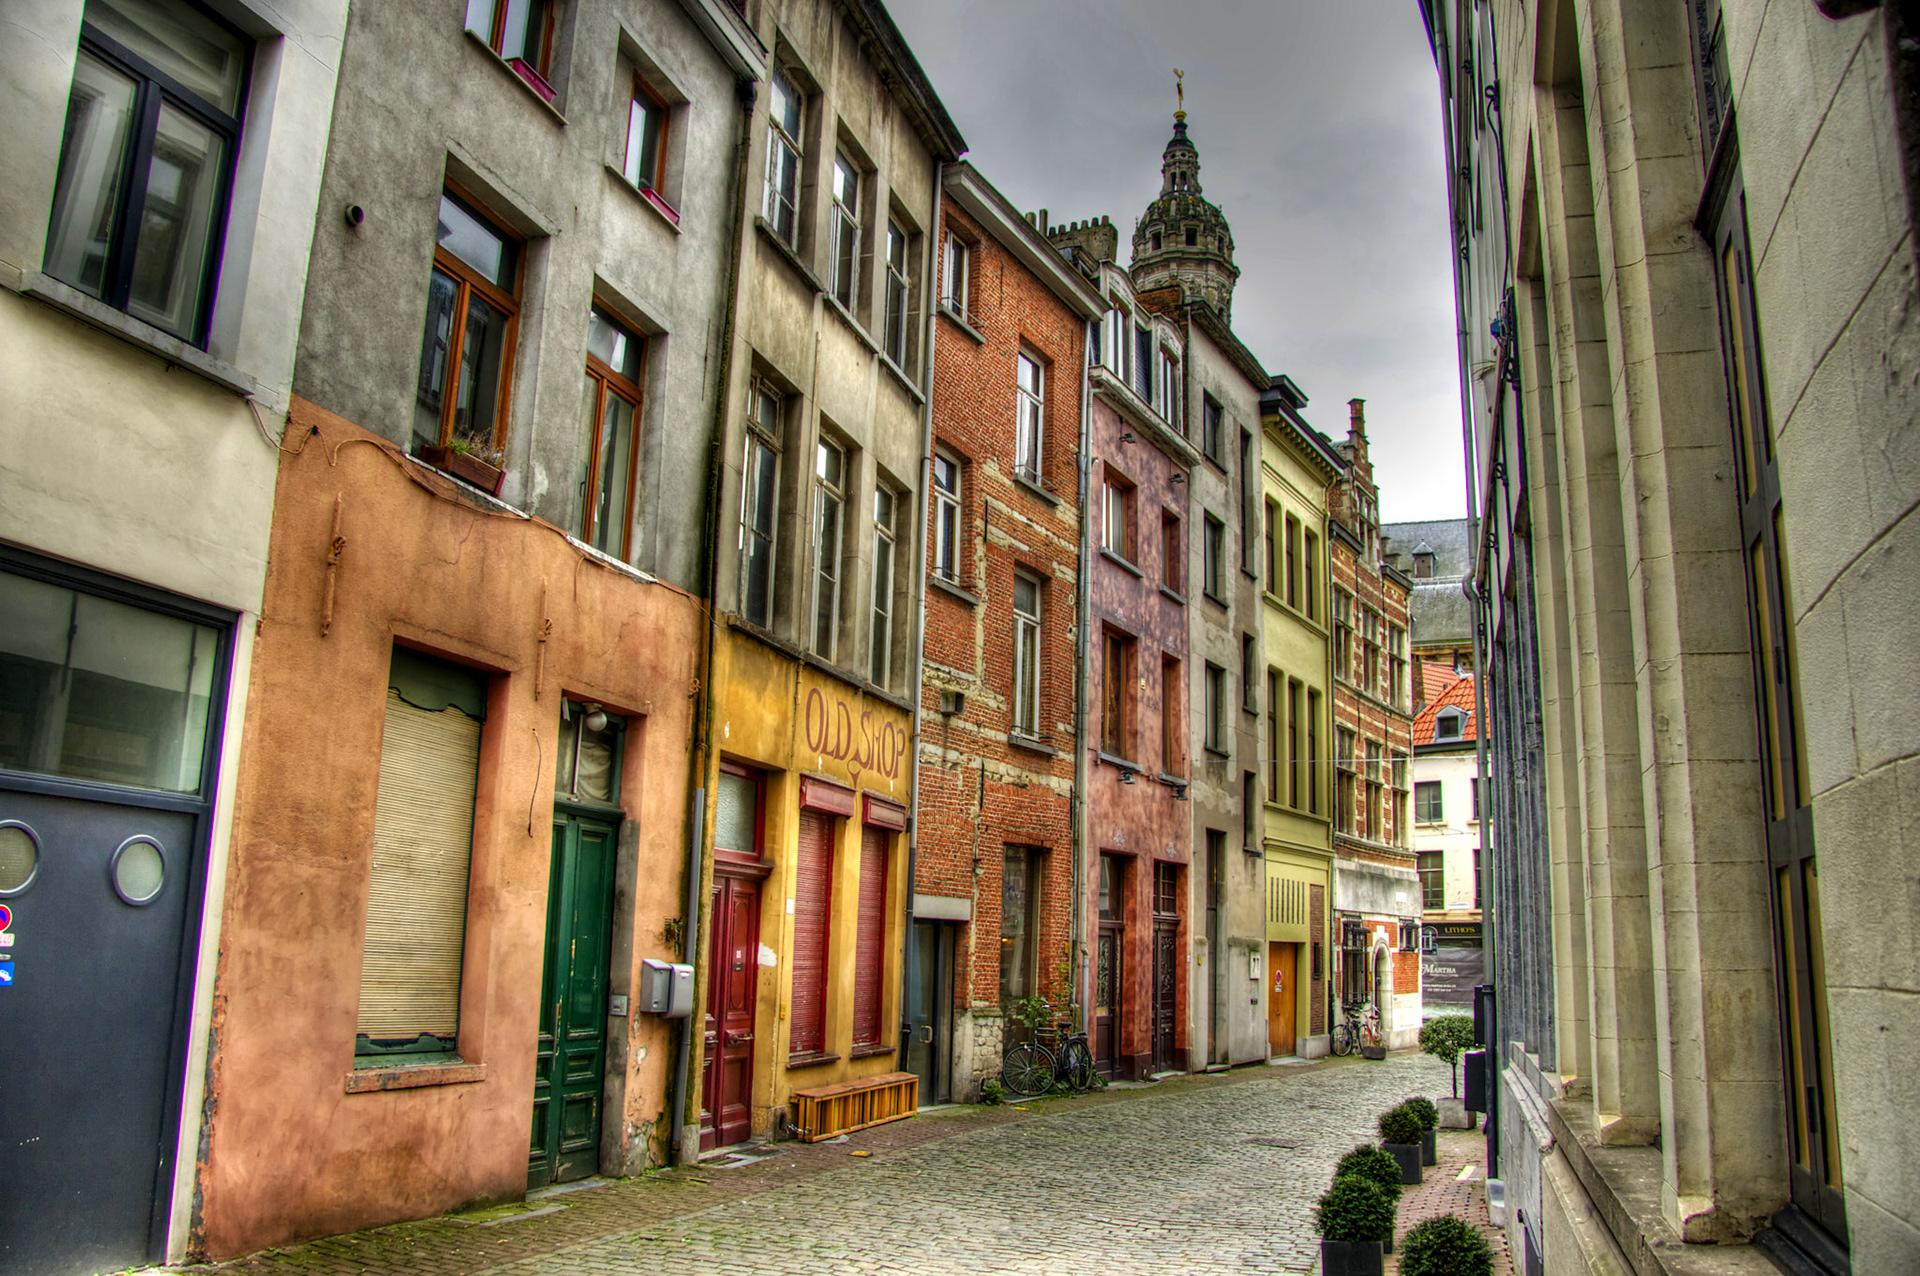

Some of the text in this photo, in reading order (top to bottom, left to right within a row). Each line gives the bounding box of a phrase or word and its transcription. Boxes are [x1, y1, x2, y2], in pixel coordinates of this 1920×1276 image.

[805, 687, 906, 780] OLD SHOP
[1444, 926, 1476, 934] LITHO'S
